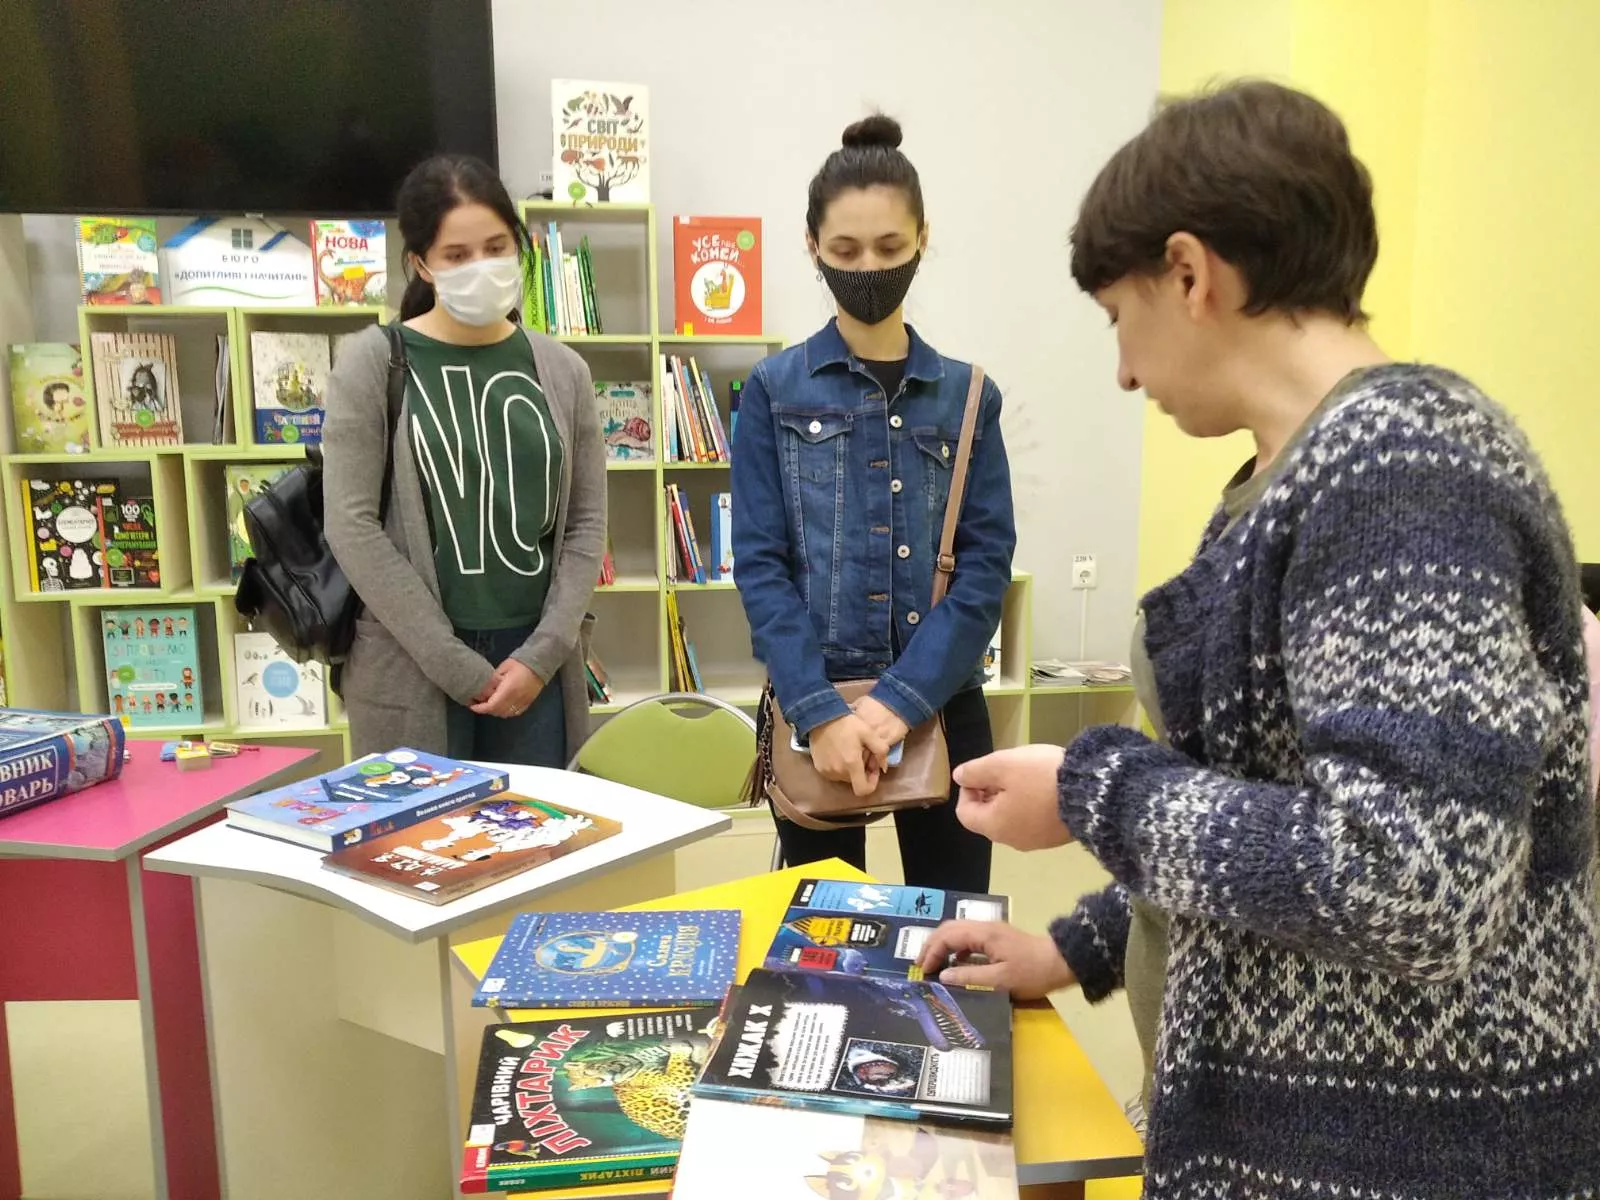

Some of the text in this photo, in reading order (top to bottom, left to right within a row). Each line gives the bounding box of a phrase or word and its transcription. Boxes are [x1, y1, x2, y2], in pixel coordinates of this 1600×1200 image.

[568, 134, 638, 155] ПРИРОДИ
[325, 235, 369, 252] НОВА
[727, 1020, 768, 1079] ХИЖАК
[491, 1056, 521, 1125] ЧАРІВНИЙ
[516, 1024, 592, 1154] ЛІХТАРИК
[580, 1168, 645, 1181] ЛІХТАРИК
